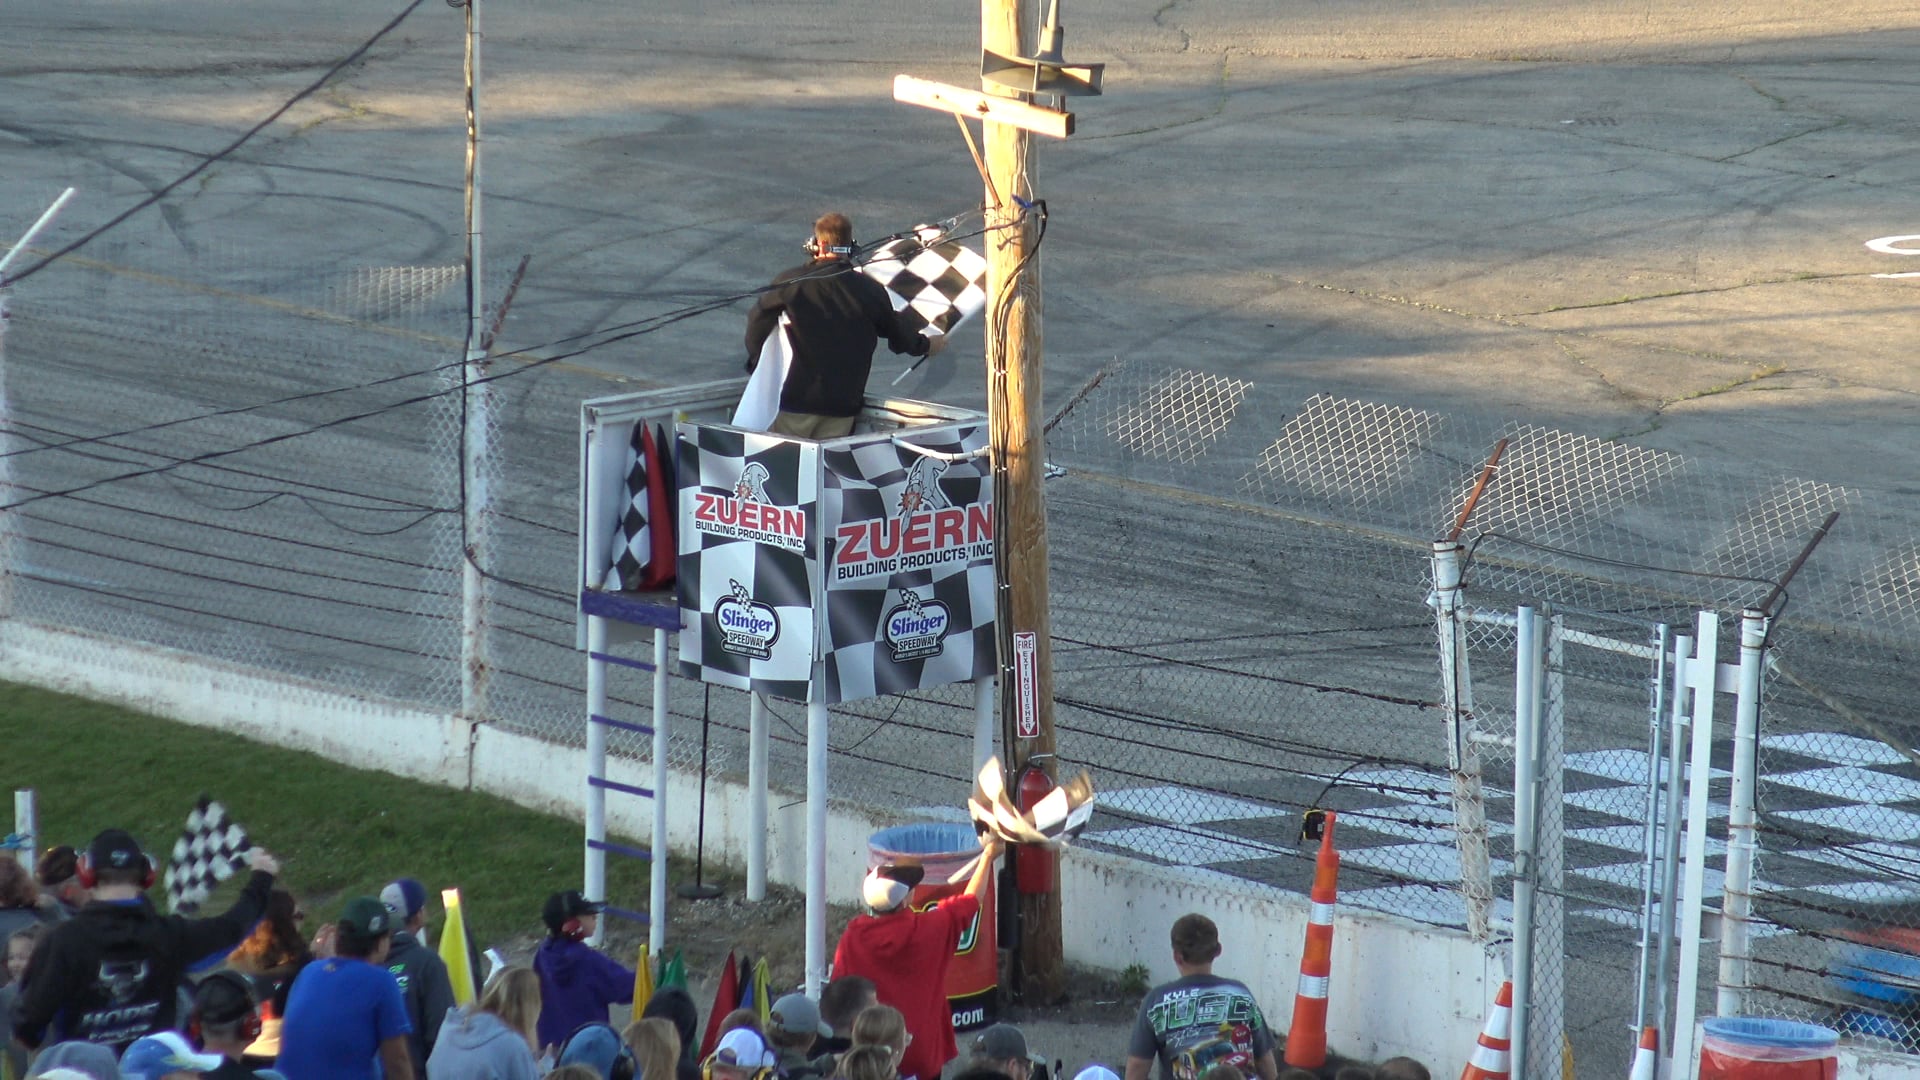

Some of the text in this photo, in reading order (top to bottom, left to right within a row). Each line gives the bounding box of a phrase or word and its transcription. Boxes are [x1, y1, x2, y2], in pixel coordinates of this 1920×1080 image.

[695, 493, 804, 538] ZUERN
[695, 520, 736, 536] BUILDING
[738, 528, 785, 546] PRODUCTS,
[837, 503, 993, 565] ZUERN
[837, 558, 897, 580] BUILDING
[900, 547, 970, 570] PRODUCTS,
[721, 608, 773, 634] Slinger
[890, 614, 945, 636] Slinger
[728, 632, 764, 648] SPEEDWAY
[898, 635, 936, 651] SPEEDWAY
[1017, 640, 1033, 649] FIRE
[1022, 650, 1031, 729] EXTINGUISHER
[1163, 988, 1200, 1002] KYLE
